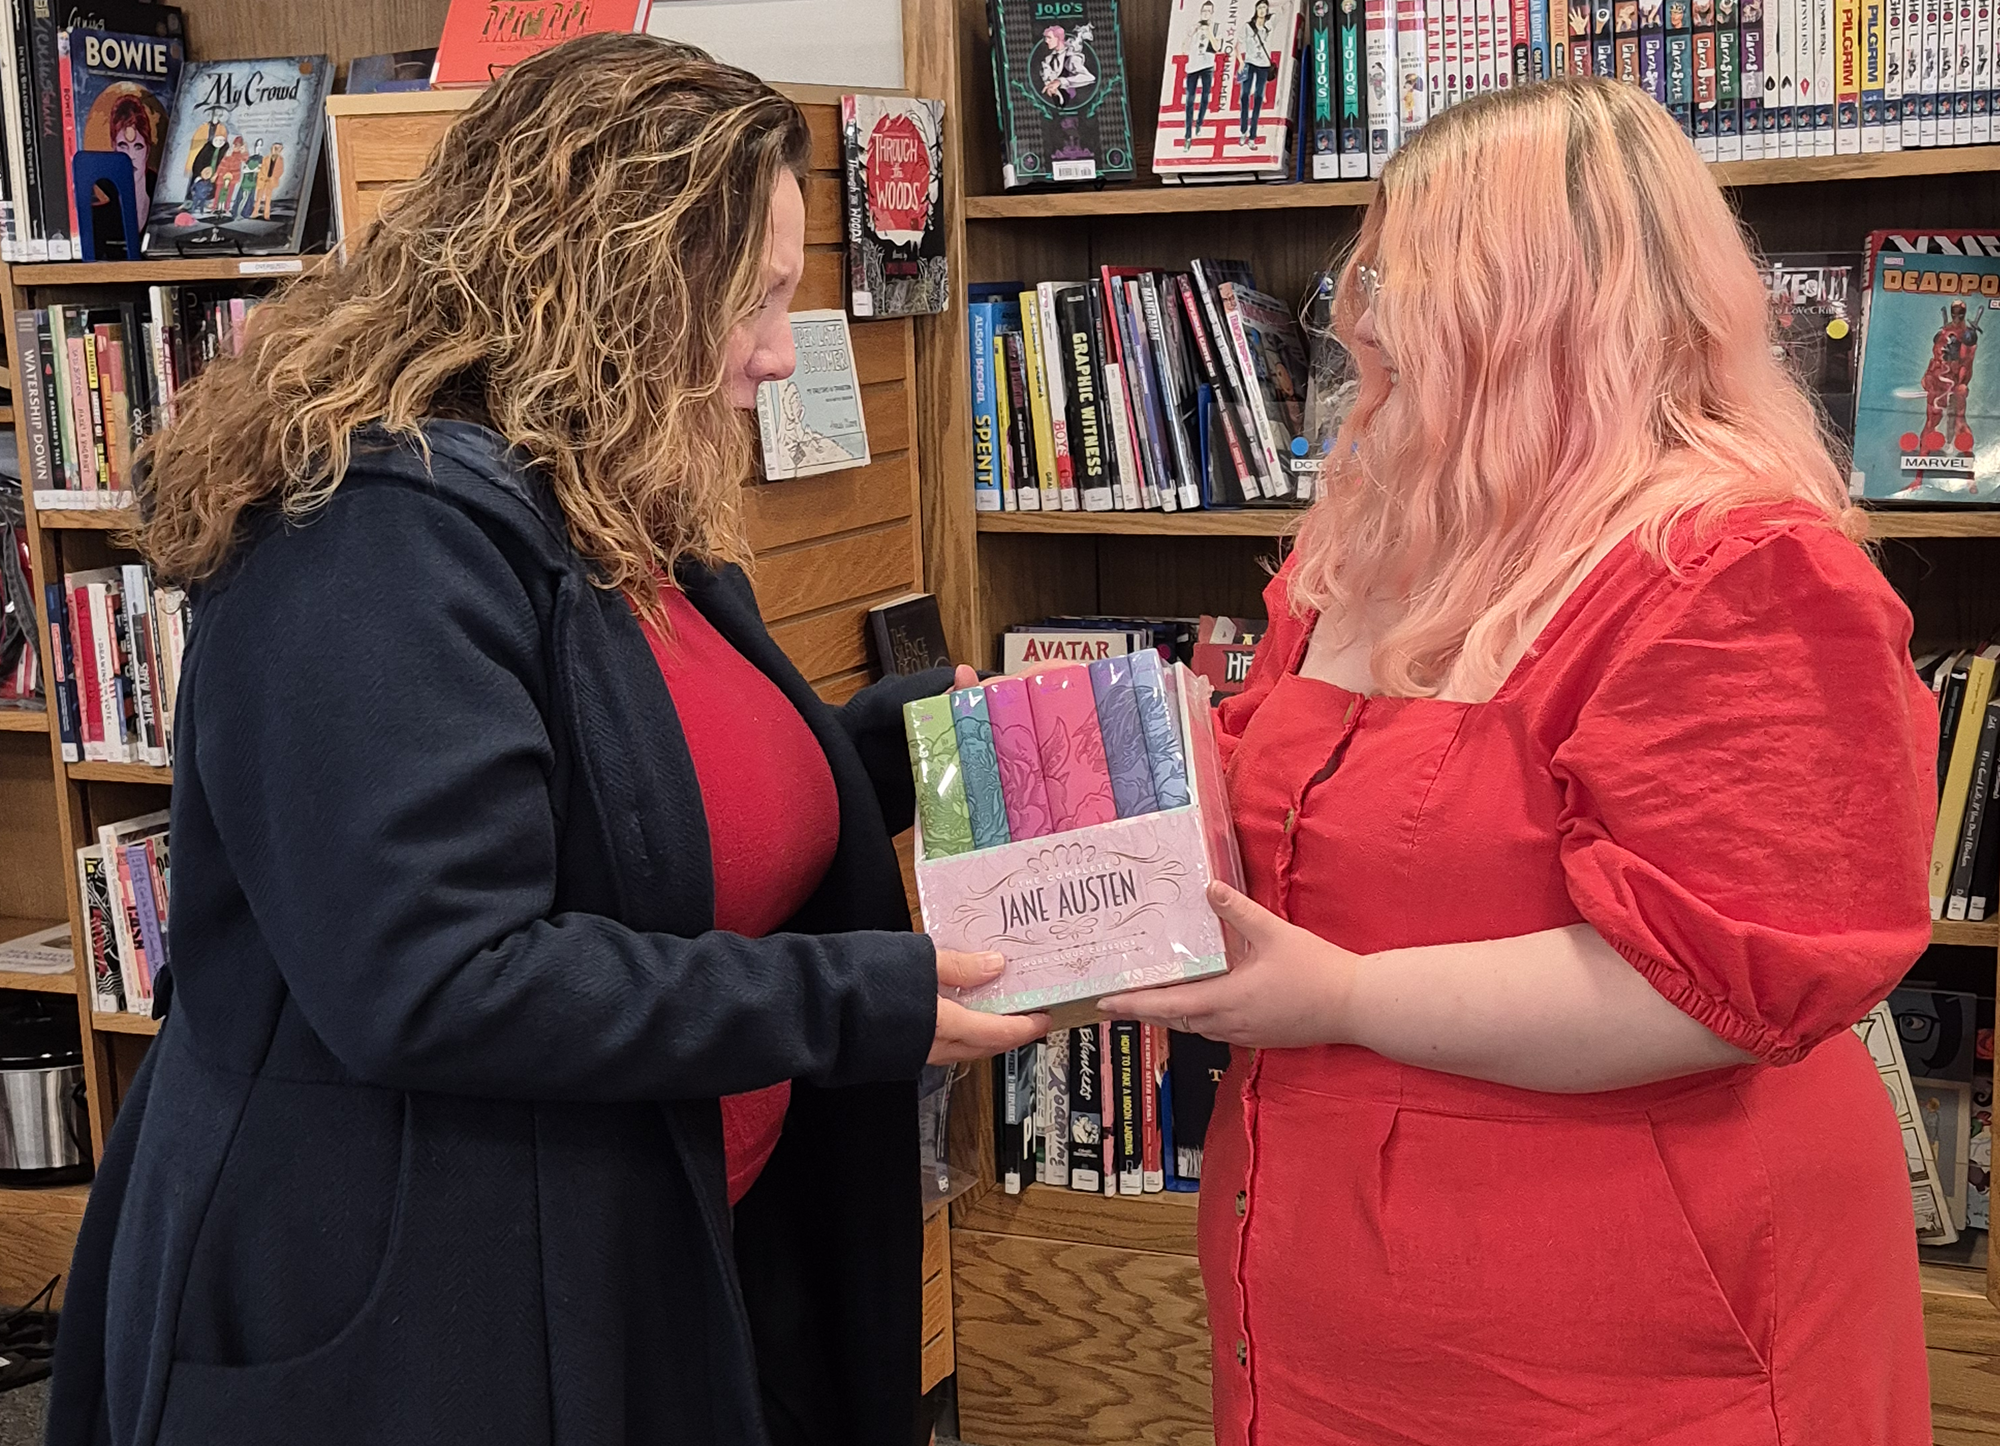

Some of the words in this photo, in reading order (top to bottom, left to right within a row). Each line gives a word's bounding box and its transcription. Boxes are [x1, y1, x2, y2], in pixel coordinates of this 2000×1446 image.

[1228, 0, 1239, 26] AINT
[1516, 9, 1527, 40] KOONTZ
[1532, 13, 1542, 43] KOONTZ
[1909, 0, 1919, 45] HOUL
[1927, 0, 1937, 45] HOUL
[1943, 0, 1953, 44] HOUL
[1960, 0, 1970, 41] HOUL
[1978, 0, 1989, 41] HOUL
[85, 35, 168, 74] BOWIE
[1428, 17, 1440, 63] NANA
[1445, 15, 1457, 62] NANA
[1463, 16, 1474, 63] NANA
[1478, 15, 1490, 61] NANA
[1497, 16, 1508, 58] NANA
[1842, 8, 1854, 86] PILGRIM
[1867, 5, 1879, 83] PILGRIM
[1221, 38, 1235, 82] YOUNG
[1888, 63, 1899, 76] 2
[20, 76, 30, 117] SHADOW
[193, 73, 243, 112] My
[244, 70, 301, 107] Crowd
[1432, 75, 1439, 89] 1
[1448, 74, 1456, 88] 2
[1465, 75, 1474, 89] 3
[1482, 73, 1490, 88] 4
[63, 88, 73, 119] BOWIE
[1218, 85, 1228, 112] MEN
[24, 131, 32, 145] NO
[872, 133, 918, 175] THROUGH
[26, 147, 36, 186] TOWERS
[875, 181, 921, 211] WOODS
[849, 207, 863, 244] WOODS
[1883, 269, 2000, 297] DEADPO
[974, 314, 985, 346] ALISON
[1141, 287, 1160, 341] MANGAMAN
[803, 349, 849, 374] BLOOMER
[1072, 331, 1095, 404] GRAPHIC
[24, 349, 42, 430] WATERSHIP
[33, 433, 48, 480] DOWN
[973, 413, 995, 486] SPENT
[1081, 405, 1102, 477] WITNESS
[1294, 461, 1313, 469] DC
[1905, 457, 1970, 469] MARVEL
[890, 625, 909, 644] THE
[1022, 638, 1111, 662] AVATAR
[98, 642, 108, 683] DRAWING
[104, 699, 112, 720] VOTE
[1225, 651, 1256, 682] HE
[1017, 875, 1041, 887] THE
[1047, 862, 1113, 884] COMPLETE
[1000, 885, 1051, 935] JANE
[1058, 868, 1138, 919] AUSTEN
[1021, 958, 1049, 969] WORD
[1053, 950, 1086, 964] CLOUD
[1088, 938, 1136, 955] CLASSICS
[1121, 1035, 1131, 1055] HOW
[1121, 1056, 1131, 1066] TO
[1079, 1027, 1096, 1101] Blankets
[1122, 1067, 1132, 1087] FAKE
[1208, 1067, 1224, 1082] T
[1048, 1062, 1070, 1167] Roaming
[1123, 1095, 1133, 1120] MOON
[1123, 1121, 1134, 1155] LANDING
